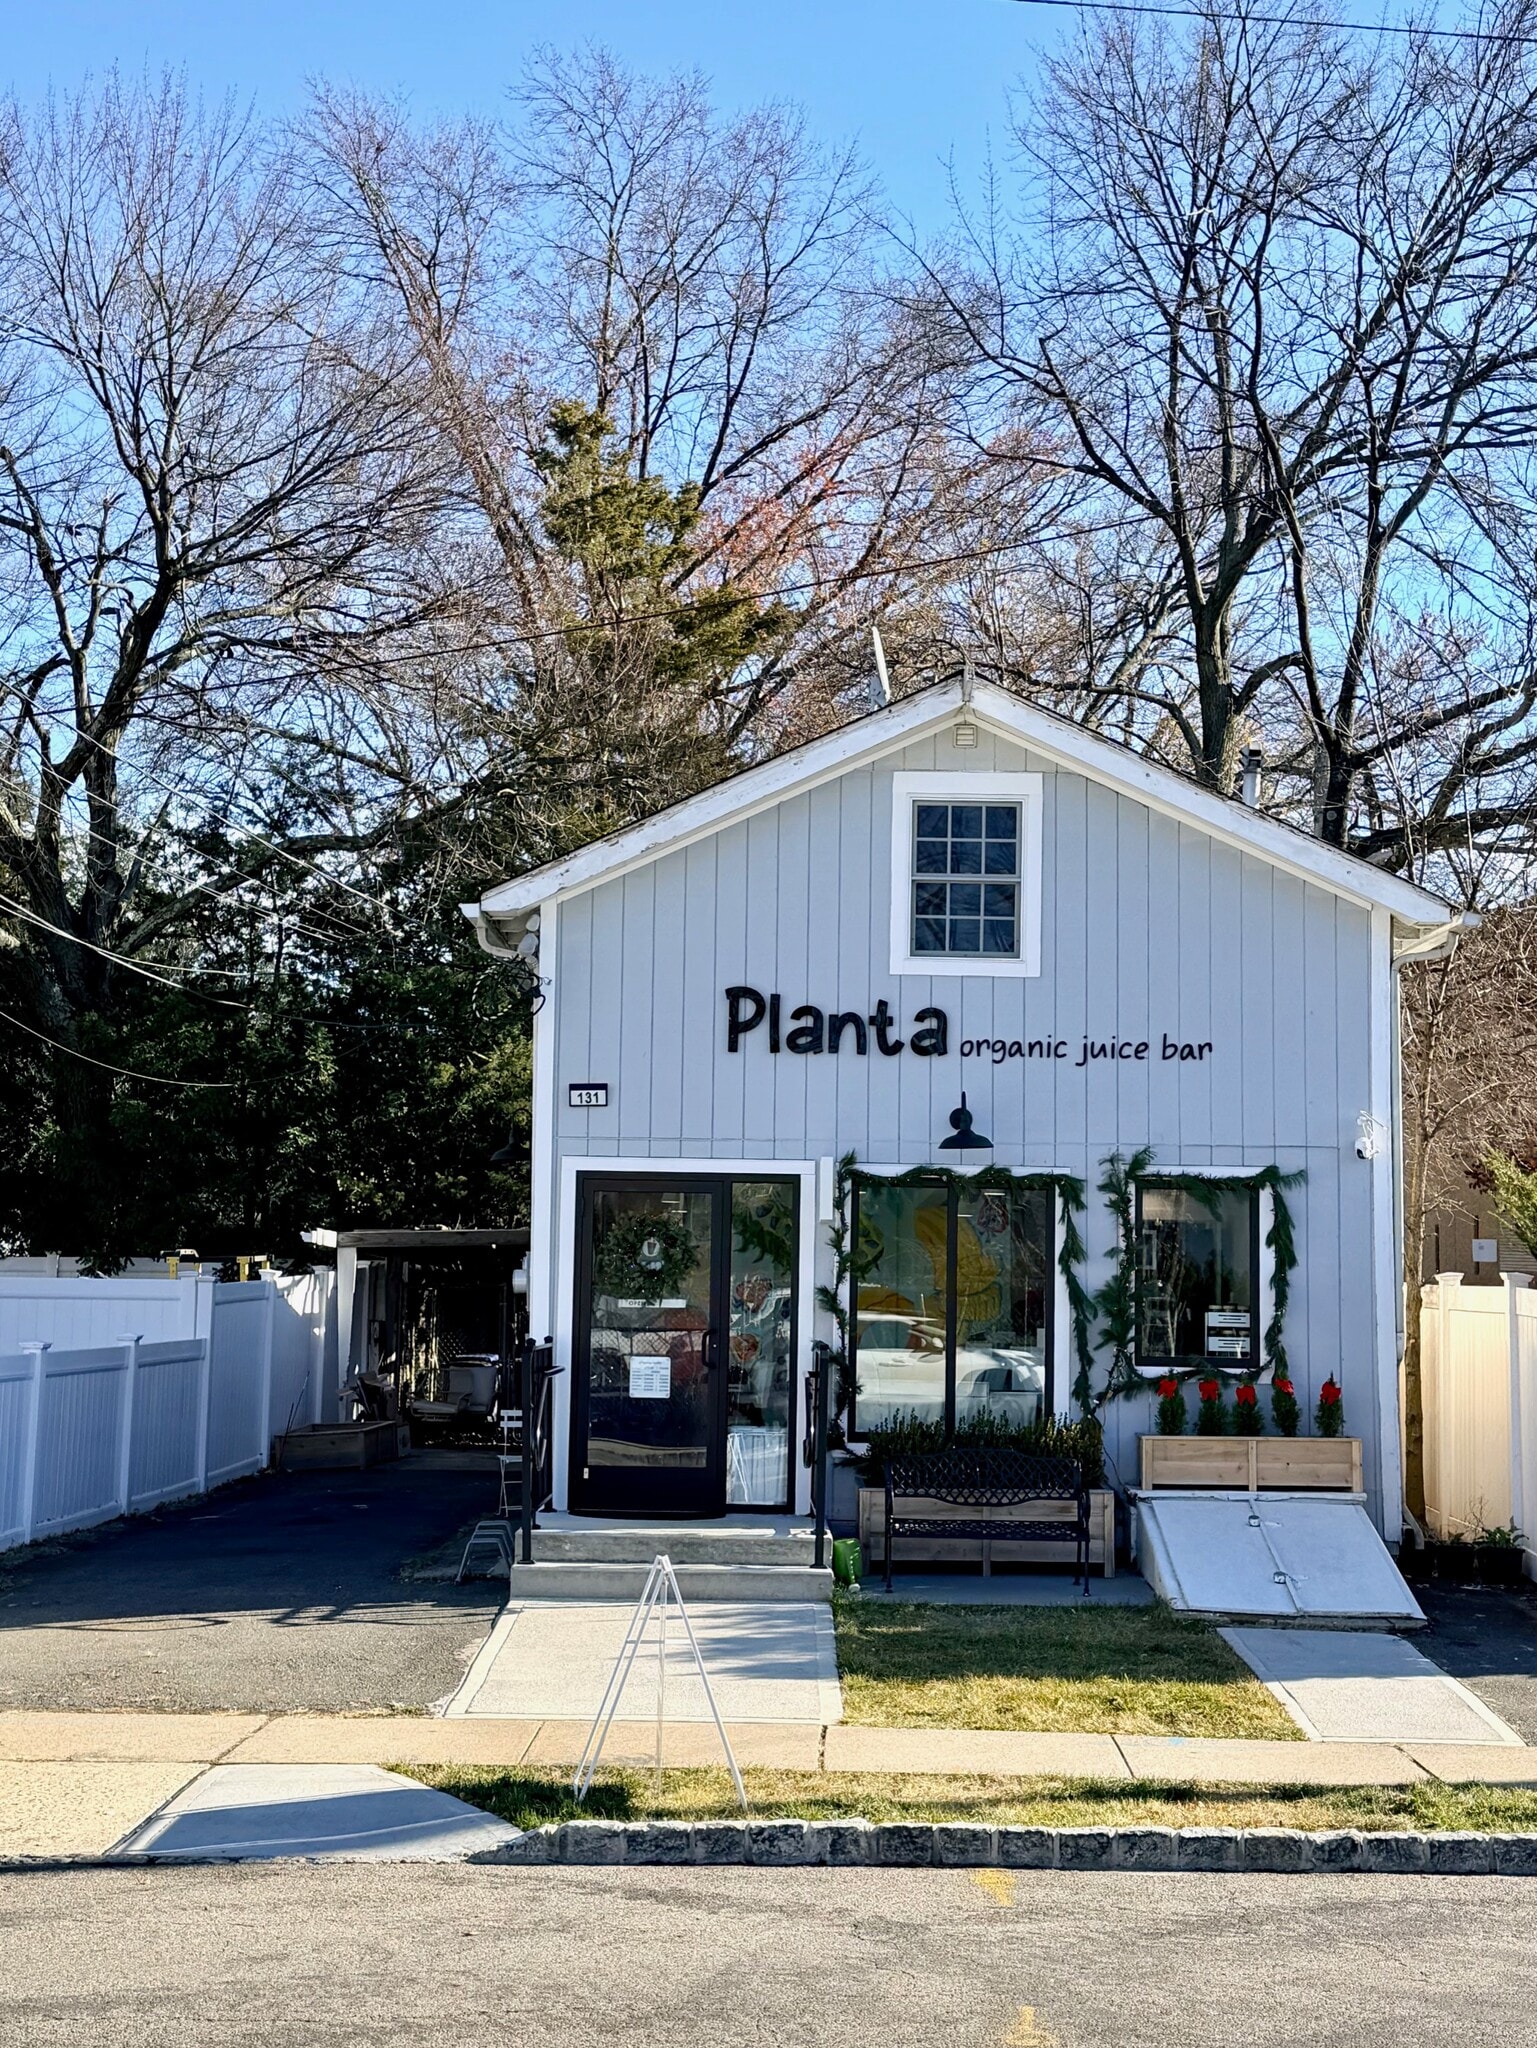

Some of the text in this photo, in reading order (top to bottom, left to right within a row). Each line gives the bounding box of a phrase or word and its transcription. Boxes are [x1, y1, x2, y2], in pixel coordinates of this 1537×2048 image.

[725, 986, 1213, 1067] Planta organic juice bar
[577, 1091, 599, 1104] 131
